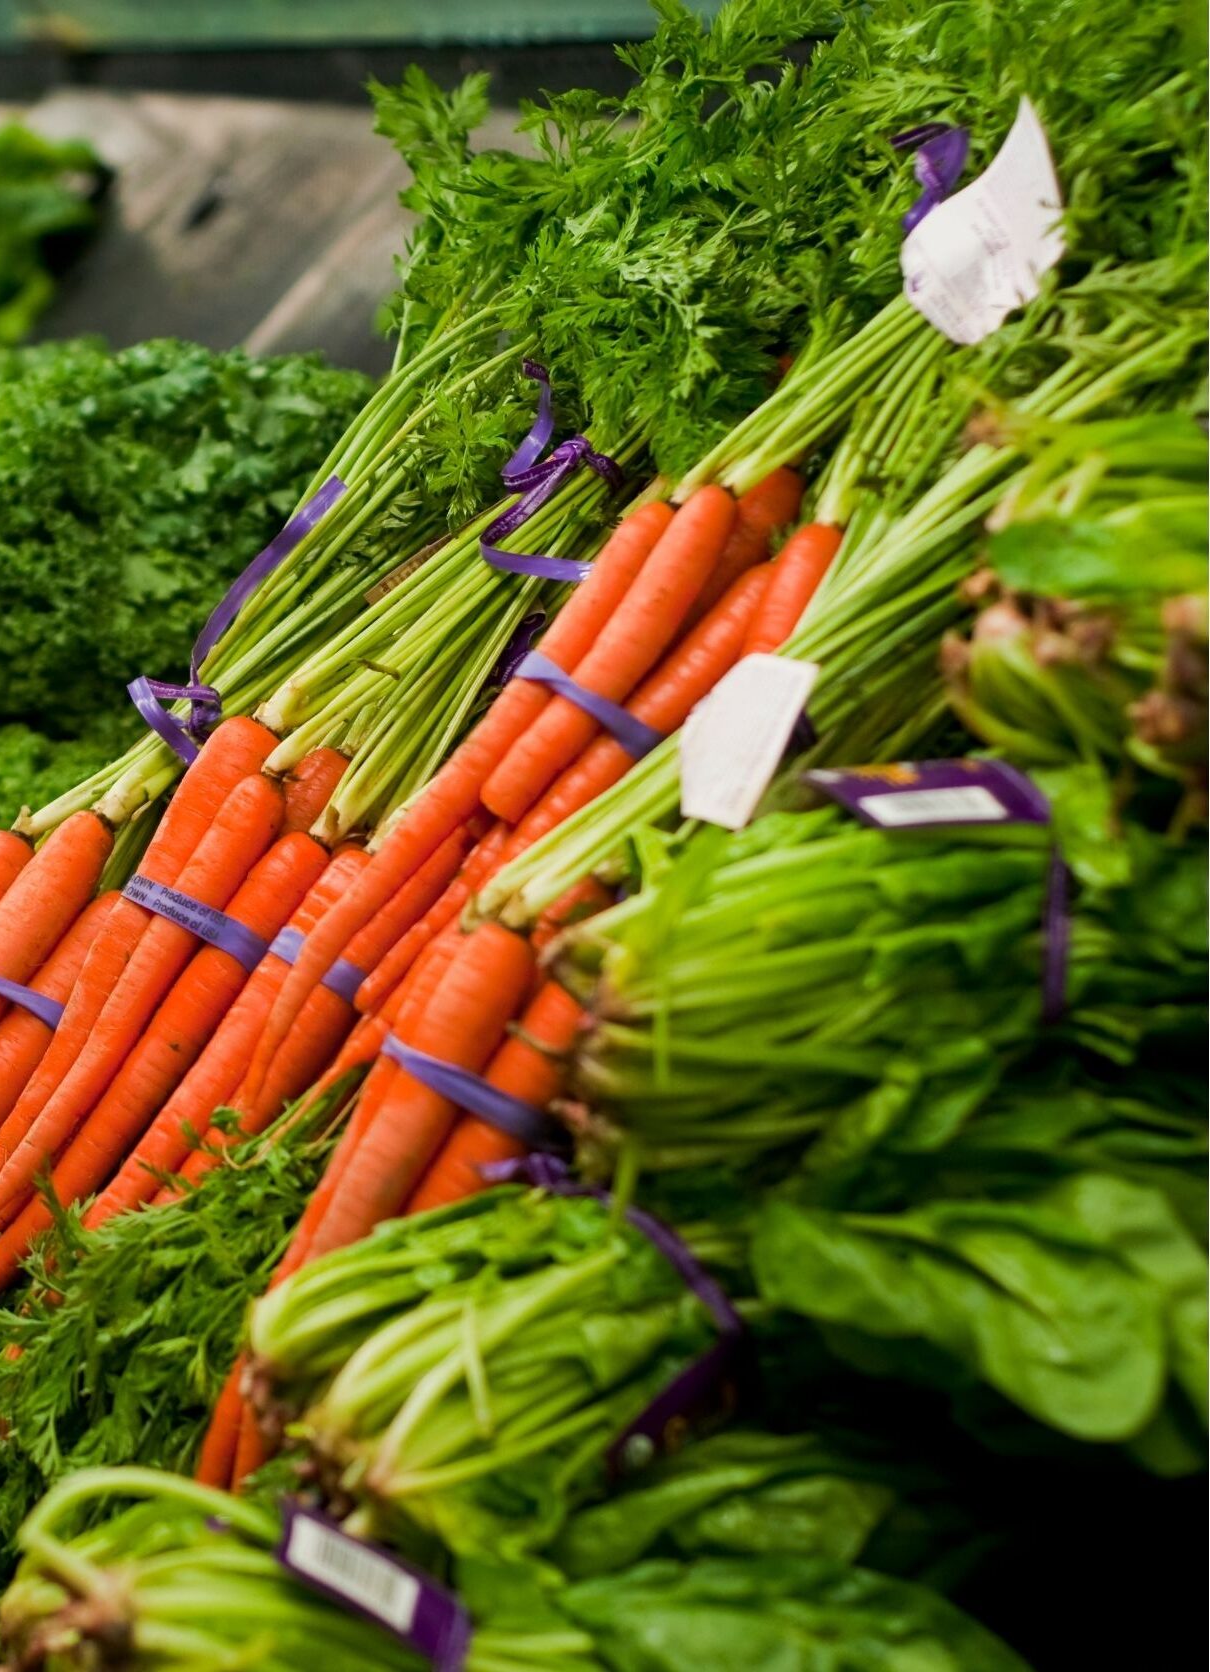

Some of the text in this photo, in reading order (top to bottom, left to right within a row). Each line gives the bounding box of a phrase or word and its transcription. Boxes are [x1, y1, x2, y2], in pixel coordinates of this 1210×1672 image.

[125, 886, 148, 902] OWN
[152, 898, 190, 924] Produce
[190, 920, 203, 931] of
[161, 887, 198, 911] Produce
[198, 907, 211, 918] of
